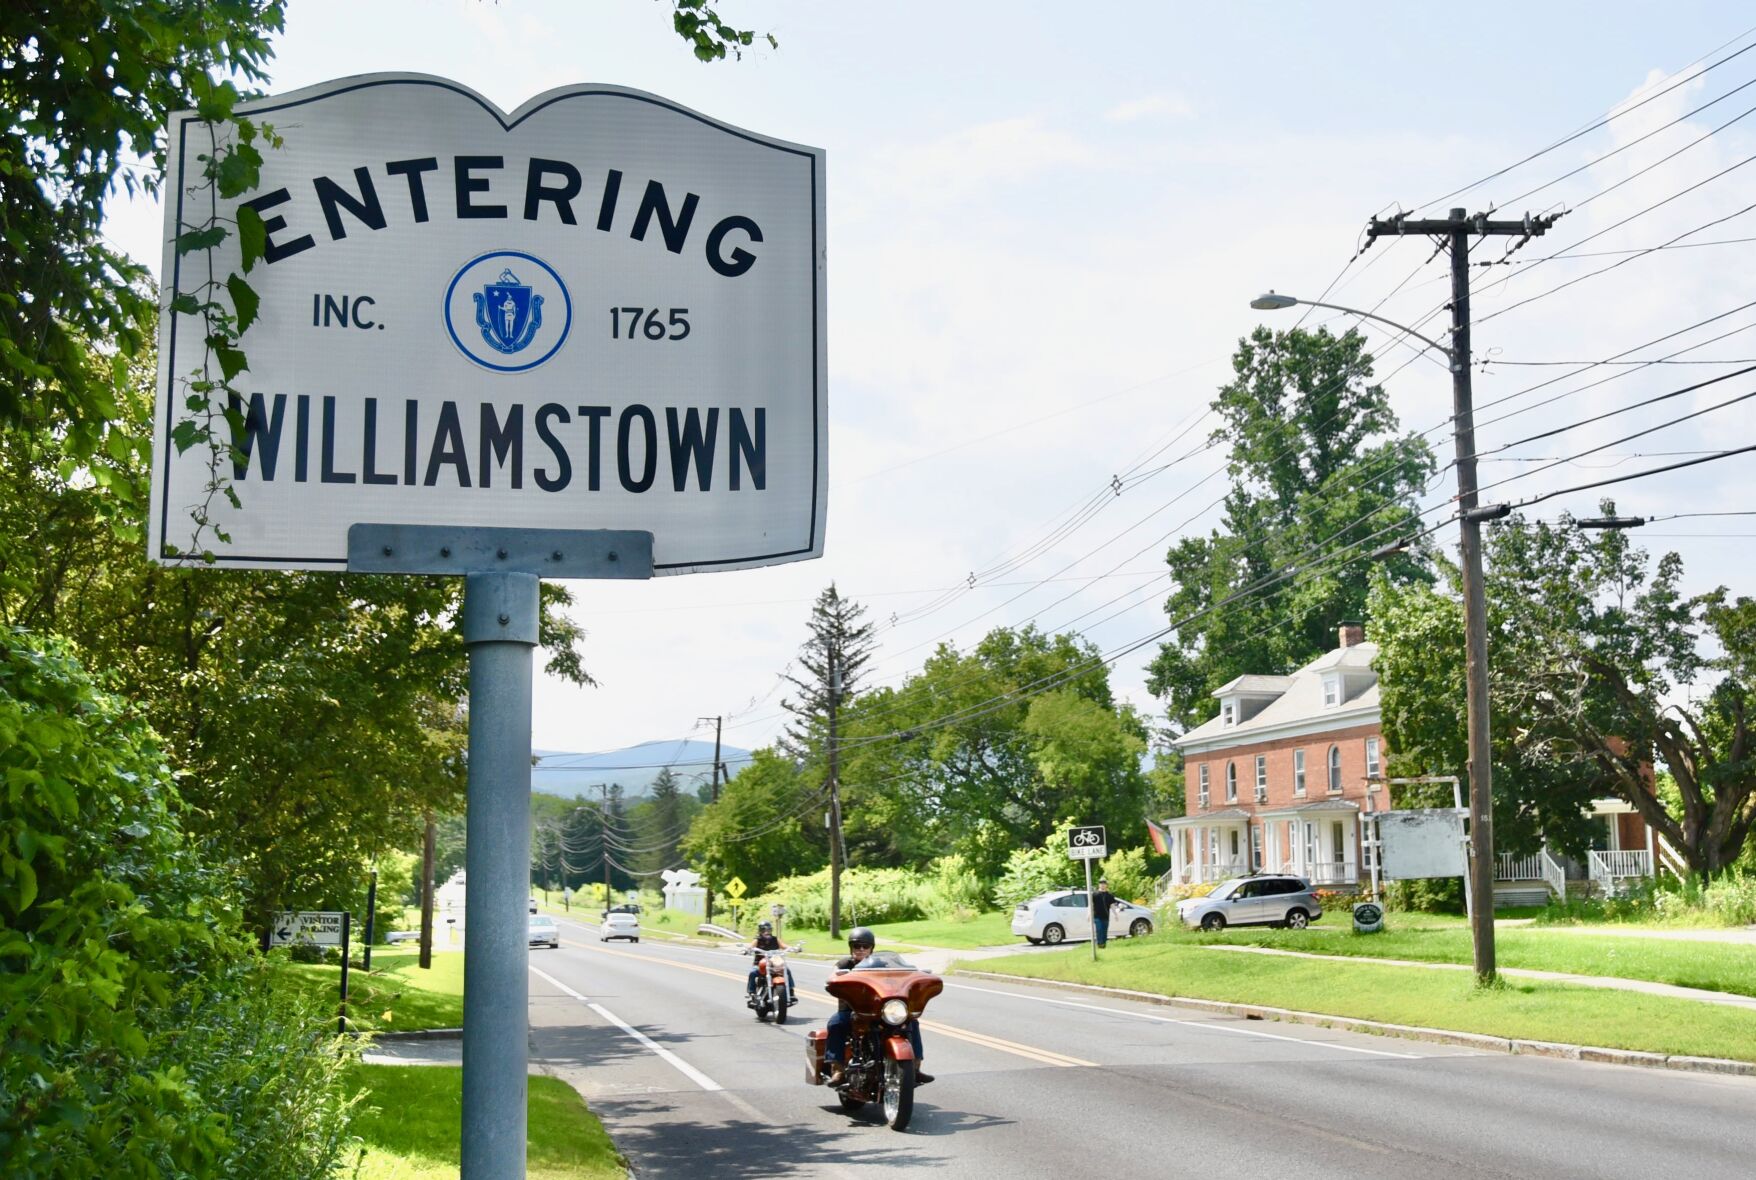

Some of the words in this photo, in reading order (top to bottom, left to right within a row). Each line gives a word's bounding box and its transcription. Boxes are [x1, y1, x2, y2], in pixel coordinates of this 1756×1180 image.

[240, 155, 764, 278] ENTERING
[312, 293, 385, 330] INC.
[609, 307, 691, 341] 1765
[228, 392, 767, 494] WILLIAMSTOWN
[1088, 847, 1104, 855] LANE
[300, 925, 340, 933] PARKING
[303, 916, 339, 924] VISITOR
